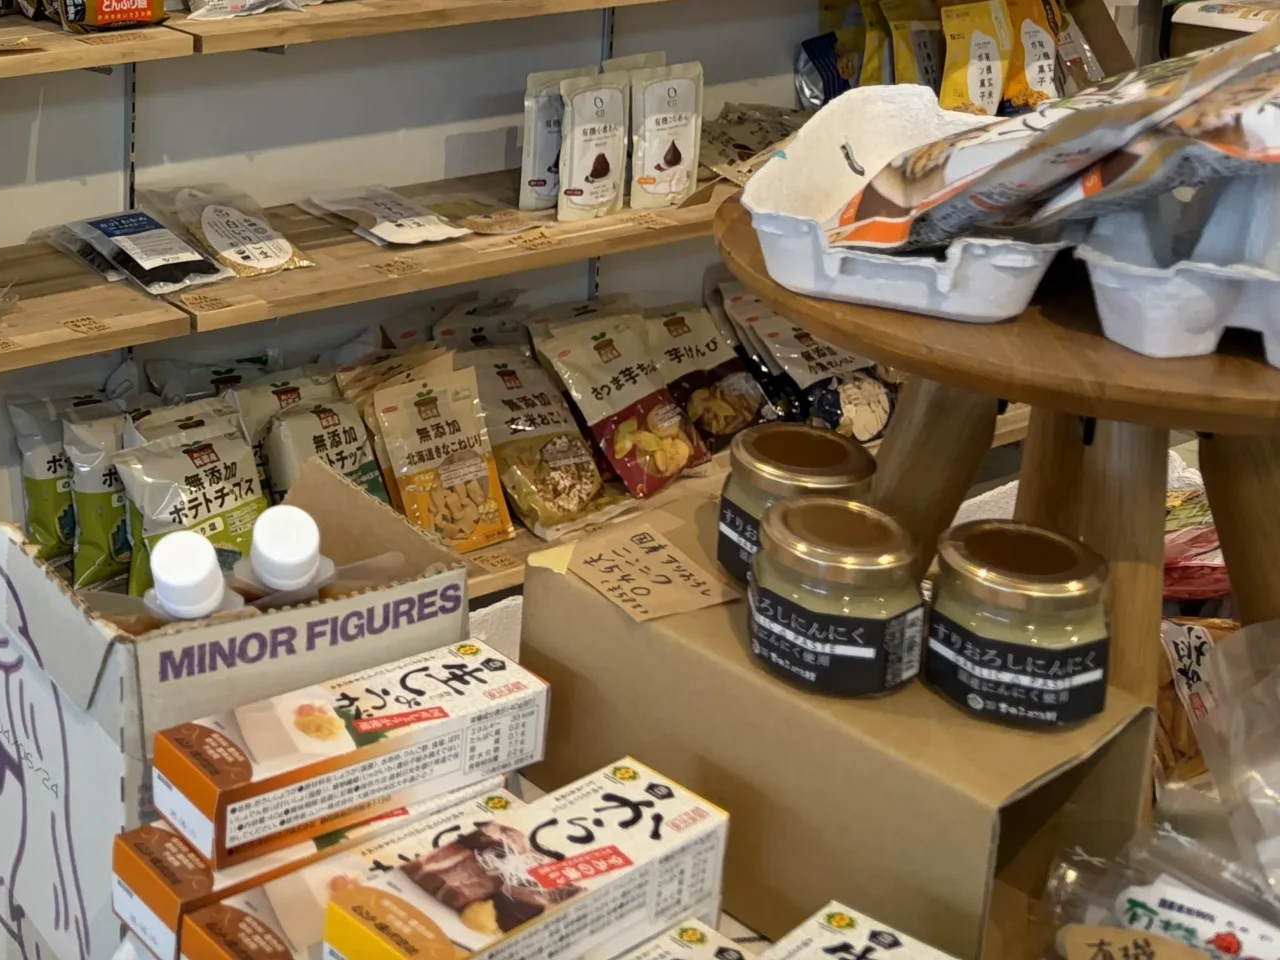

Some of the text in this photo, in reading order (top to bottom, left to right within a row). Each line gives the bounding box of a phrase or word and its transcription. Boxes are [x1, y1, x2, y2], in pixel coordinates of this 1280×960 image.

[312, 424, 358, 453] 無添加
[406, 433, 483, 467] 北海道きなこねじり
[416, 419, 462, 444] 無添加
[184, 461, 237, 495] 無添加
[168, 476, 255, 526] ポテトチップス
[583, 553, 651, 597] ¥540
[158, 583, 462, 683] MINOR FIGURES
[933, 623, 1097, 677] すりおろしにんにく
